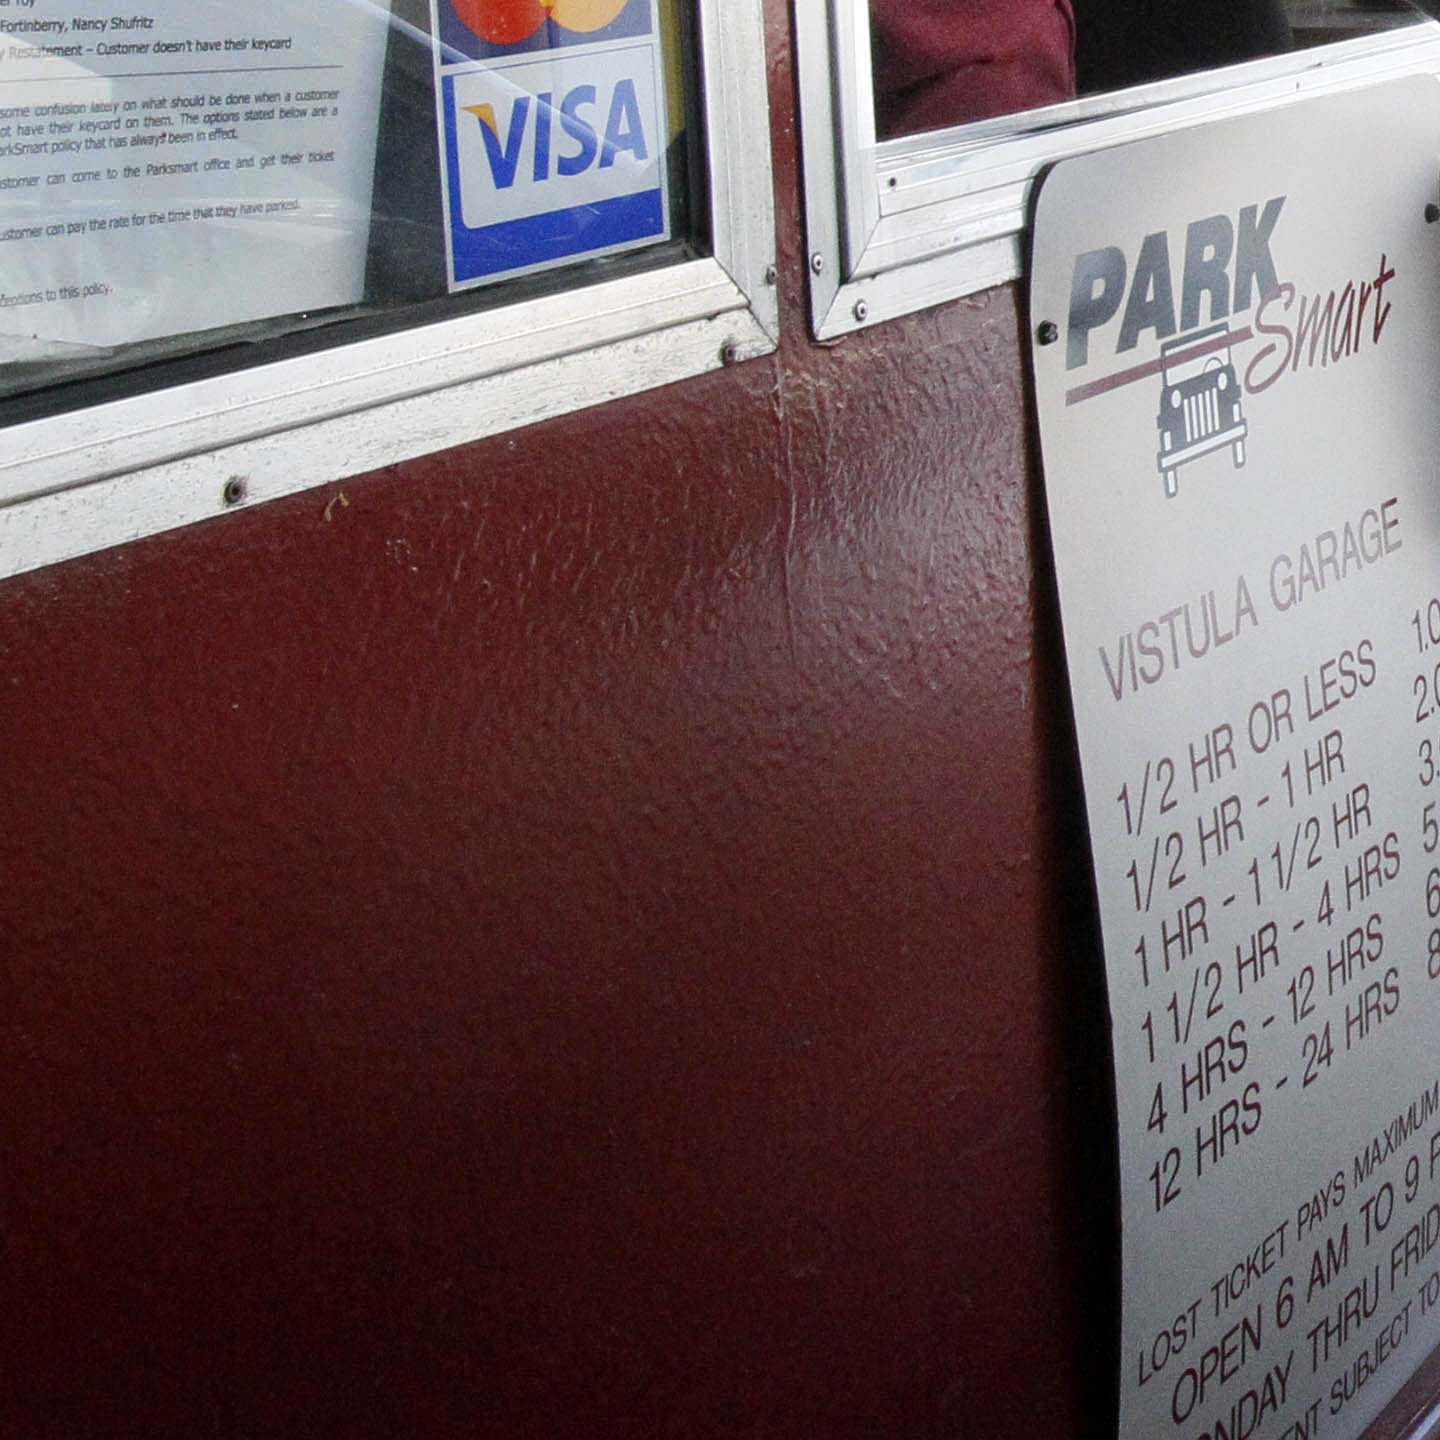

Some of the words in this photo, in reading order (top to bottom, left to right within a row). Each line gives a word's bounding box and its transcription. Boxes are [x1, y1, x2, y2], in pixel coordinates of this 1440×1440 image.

[1, 19, 68, 34] Fortinberry,
[72, 17, 108, 32] Nancy
[34, 102, 86, 117] confusion
[123, 100, 137, 111] on
[141, 97, 168, 109] what
[171, 96, 205, 108] should
[209, 94, 223, 106] be
[225, 93, 251, 105] done
[254, 92, 281, 103] when
[295, 90, 340, 102] customer
[96, 42, 150, 56] Customer
[152, 39, 193, 53] doesn't
[195, 39, 222, 52] have
[224, 38, 249, 51] their
[252, 37, 292, 52] keycard
[17, 123, 44, 136] have
[48, 122, 74, 134] their
[79, 118, 121, 134] keycard
[126, 117, 139, 128] on
[181, 113, 199, 124] The
[203, 111, 240, 125] options
[244, 108, 274, 121] stated
[279, 107, 307, 119] below
[311, 106, 328, 117] are
[47, 173, 66, 185] can
[71, 170, 101, 183] come
[106, 168, 118, 179] to
[123, 165, 141, 178] the
[203, 157, 232, 171] office
[235, 156, 255, 169] and
[51, 139, 82, 154] policy
[85, 137, 106, 150] that
[109, 135, 128, 148] has
[130, 133, 166, 148] always
[168, 131, 193, 144] been
[196, 131, 206, 142] in
[460, 78, 649, 190] VISA
[46, 224, 65, 236] can
[67, 222, 87, 236] pay
[89, 219, 107, 231] the
[109, 217, 130, 229] rate
[132, 214, 146, 226] for
[149, 212, 165, 224] the
[193, 207, 213, 220] that
[215, 205, 237, 219] they
[239, 202, 263, 214] have
[59, 285, 80, 300] this
[1065, 195, 1287, 372] PARK
[1243, 253, 1397, 395] Smart
[1099, 575, 1258, 701] VISTULA
[1269, 497, 1402, 612] GARAGE
[1117, 757, 1178, 836] 1/2
[1189, 723, 1234, 793] HR
[1248, 689, 1294, 753] OR
[1304, 639, 1375, 721] LESS
[1126, 832, 1186, 912] 1/2
[1198, 795, 1244, 866] HR
[1281, 761, 1294, 808] 1
[1304, 729, 1345, 796] HR
[1135, 935, 1148, 987] 1
[1162, 896, 1208, 972] HR
[1248, 857, 1260, 906] 1
[1272, 817, 1322, 891] 1/2
[1333, 783, 1372, 848] HR
[1141, 1011, 1154, 1062] 1
[1167, 962, 1224, 1043] 1/2
[1236, 921, 1279, 993] HR
[1318, 880, 1334, 926] 4
[1345, 832, 1400, 911] HRS
[1147, 1082, 1168, 1134] 4
[1182, 1020, 1248, 1113] HRS
[1287, 966, 1316, 1025] 12
[1327, 913, 1384, 996] HRS
[1149, 1147, 1181, 1212] 12
[1196, 1082, 1262, 1176] HRS
[1302, 1021, 1333, 1088] 24
[1345, 967, 1400, 1050] HRS
[1138, 1298, 1202, 1387] LOST
[1211, 1220, 1289, 1317] TICKET
[1297, 1171, 1346, 1241] PAYS
[1354, 1091, 1440, 1189] MAXIMUM
[1172, 1303, 1262, 1424] OPEN
[1276, 1275, 1294, 1329] 6
[1306, 1222, 1349, 1304] AM
[1360, 1182, 1394, 1247] TO
[1404, 1154, 1419, 1203] 9
[1197, 1349, 1295, 1440] NDAY
[1306, 1264, 1380, 1373] THRU
[1330, 1300, 1412, 1415] SUBJECT
[1419, 1271, 1440, 1315] TO
